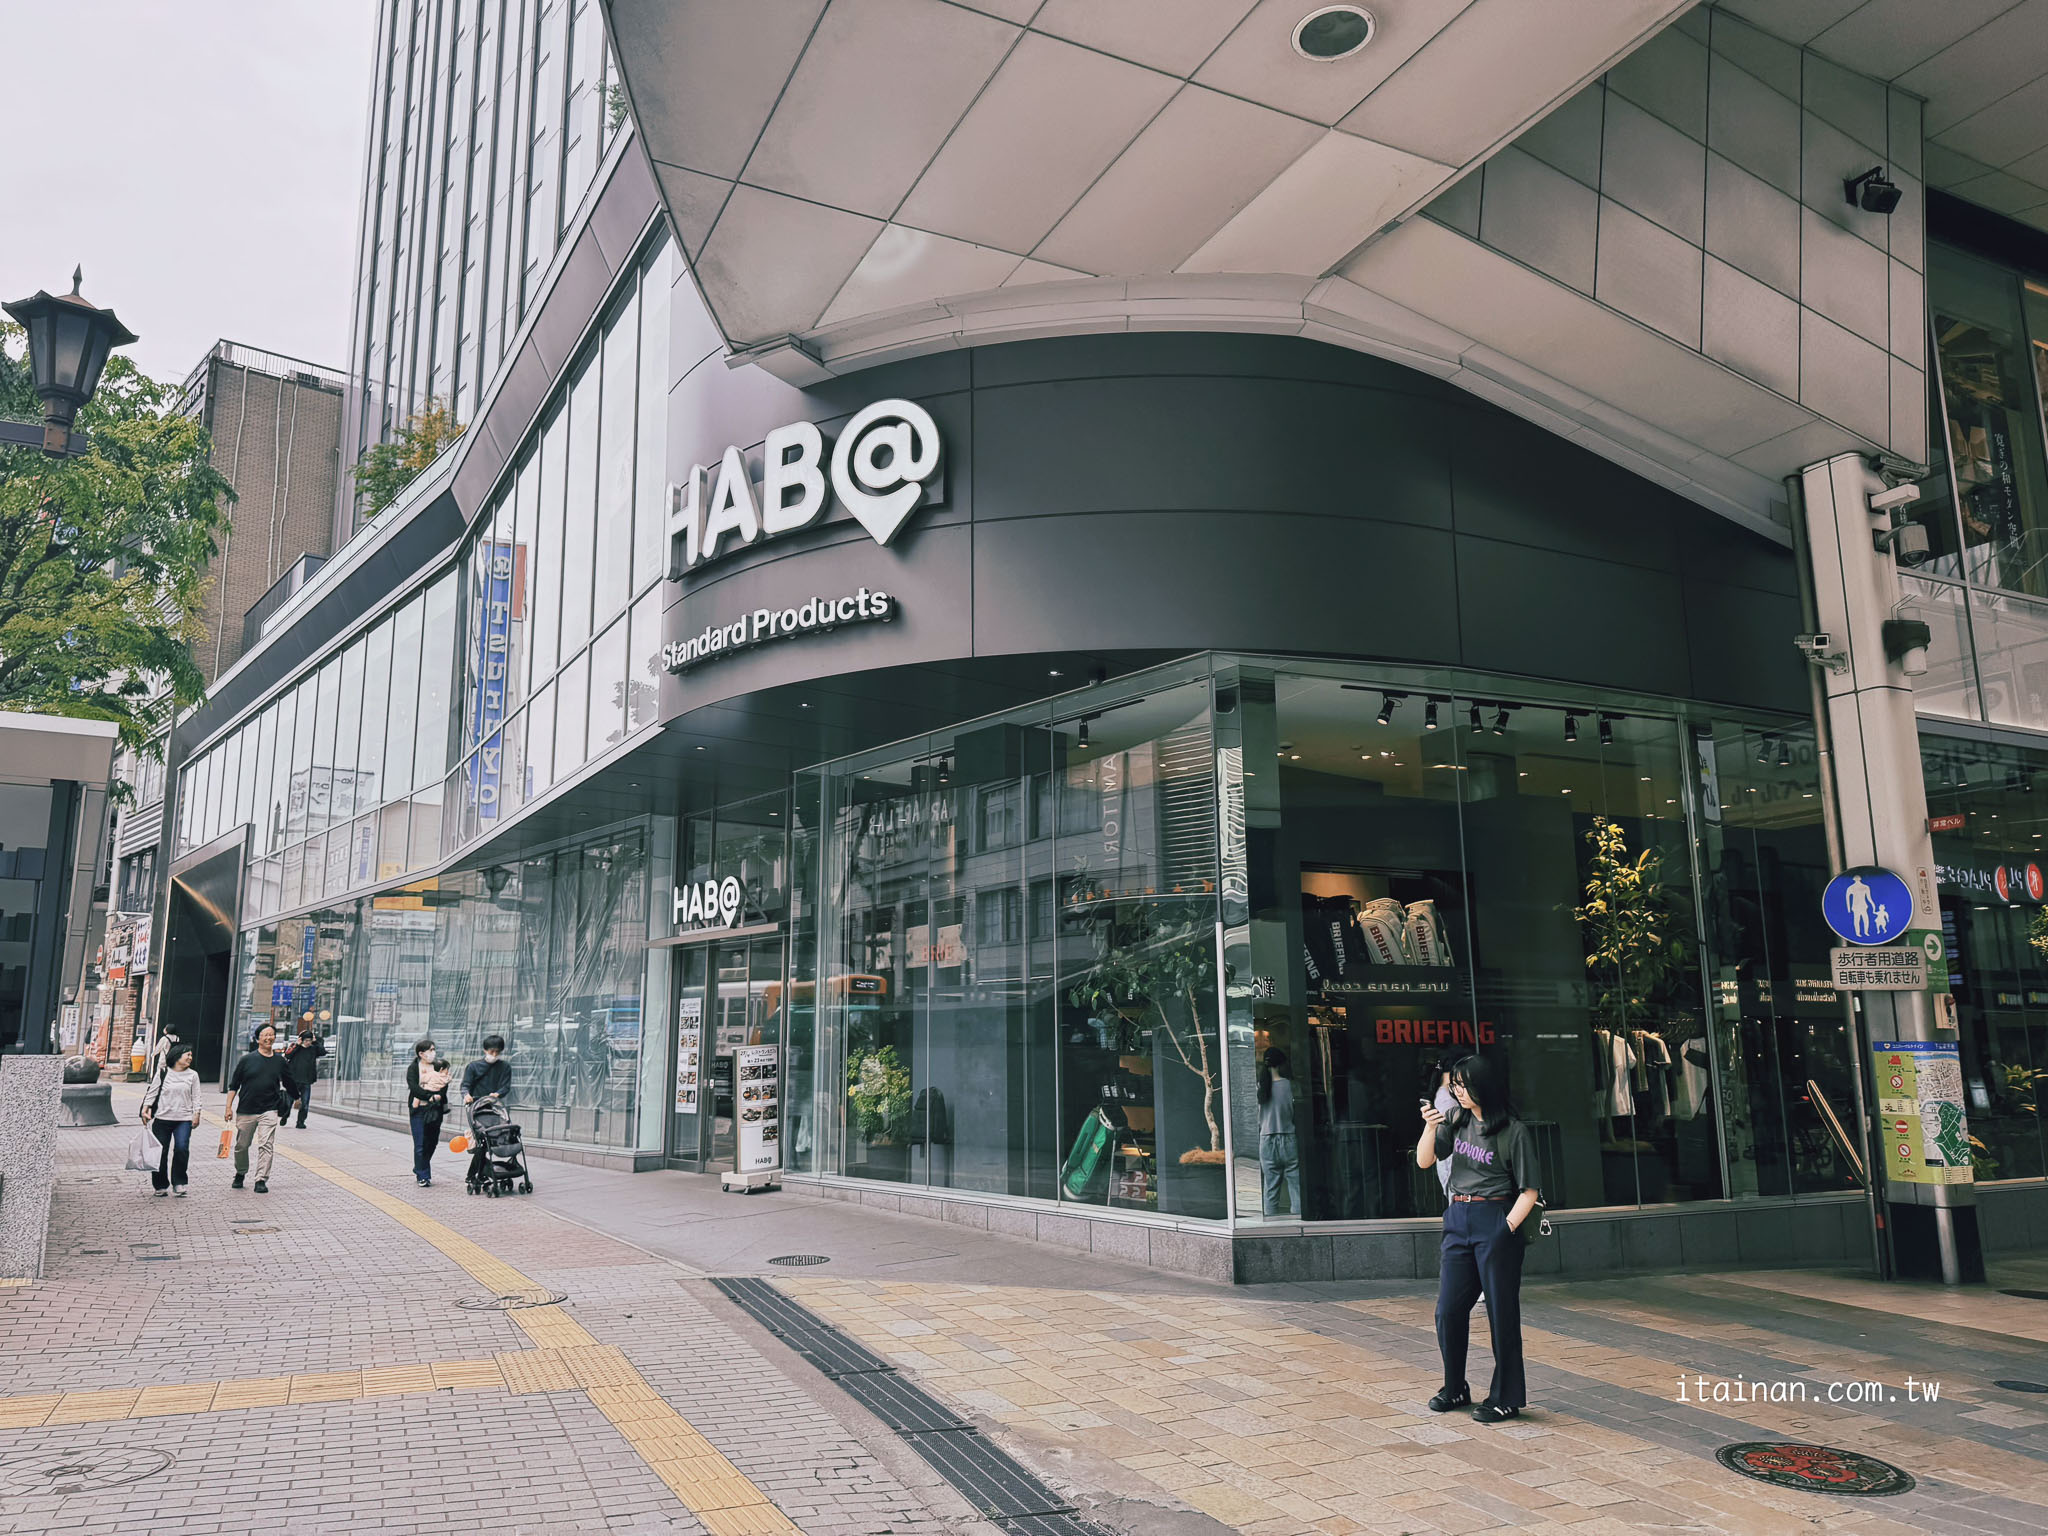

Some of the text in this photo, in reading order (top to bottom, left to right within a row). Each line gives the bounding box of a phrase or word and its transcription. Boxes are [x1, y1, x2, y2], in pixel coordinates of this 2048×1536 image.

[661, 587, 889, 672] Standard Products
[1838, 952, 1918, 967] 歩行者用道路
[1839, 969, 1920, 985] 自転車も乗れません
[1376, 1019, 1495, 1044] BRIEFING
